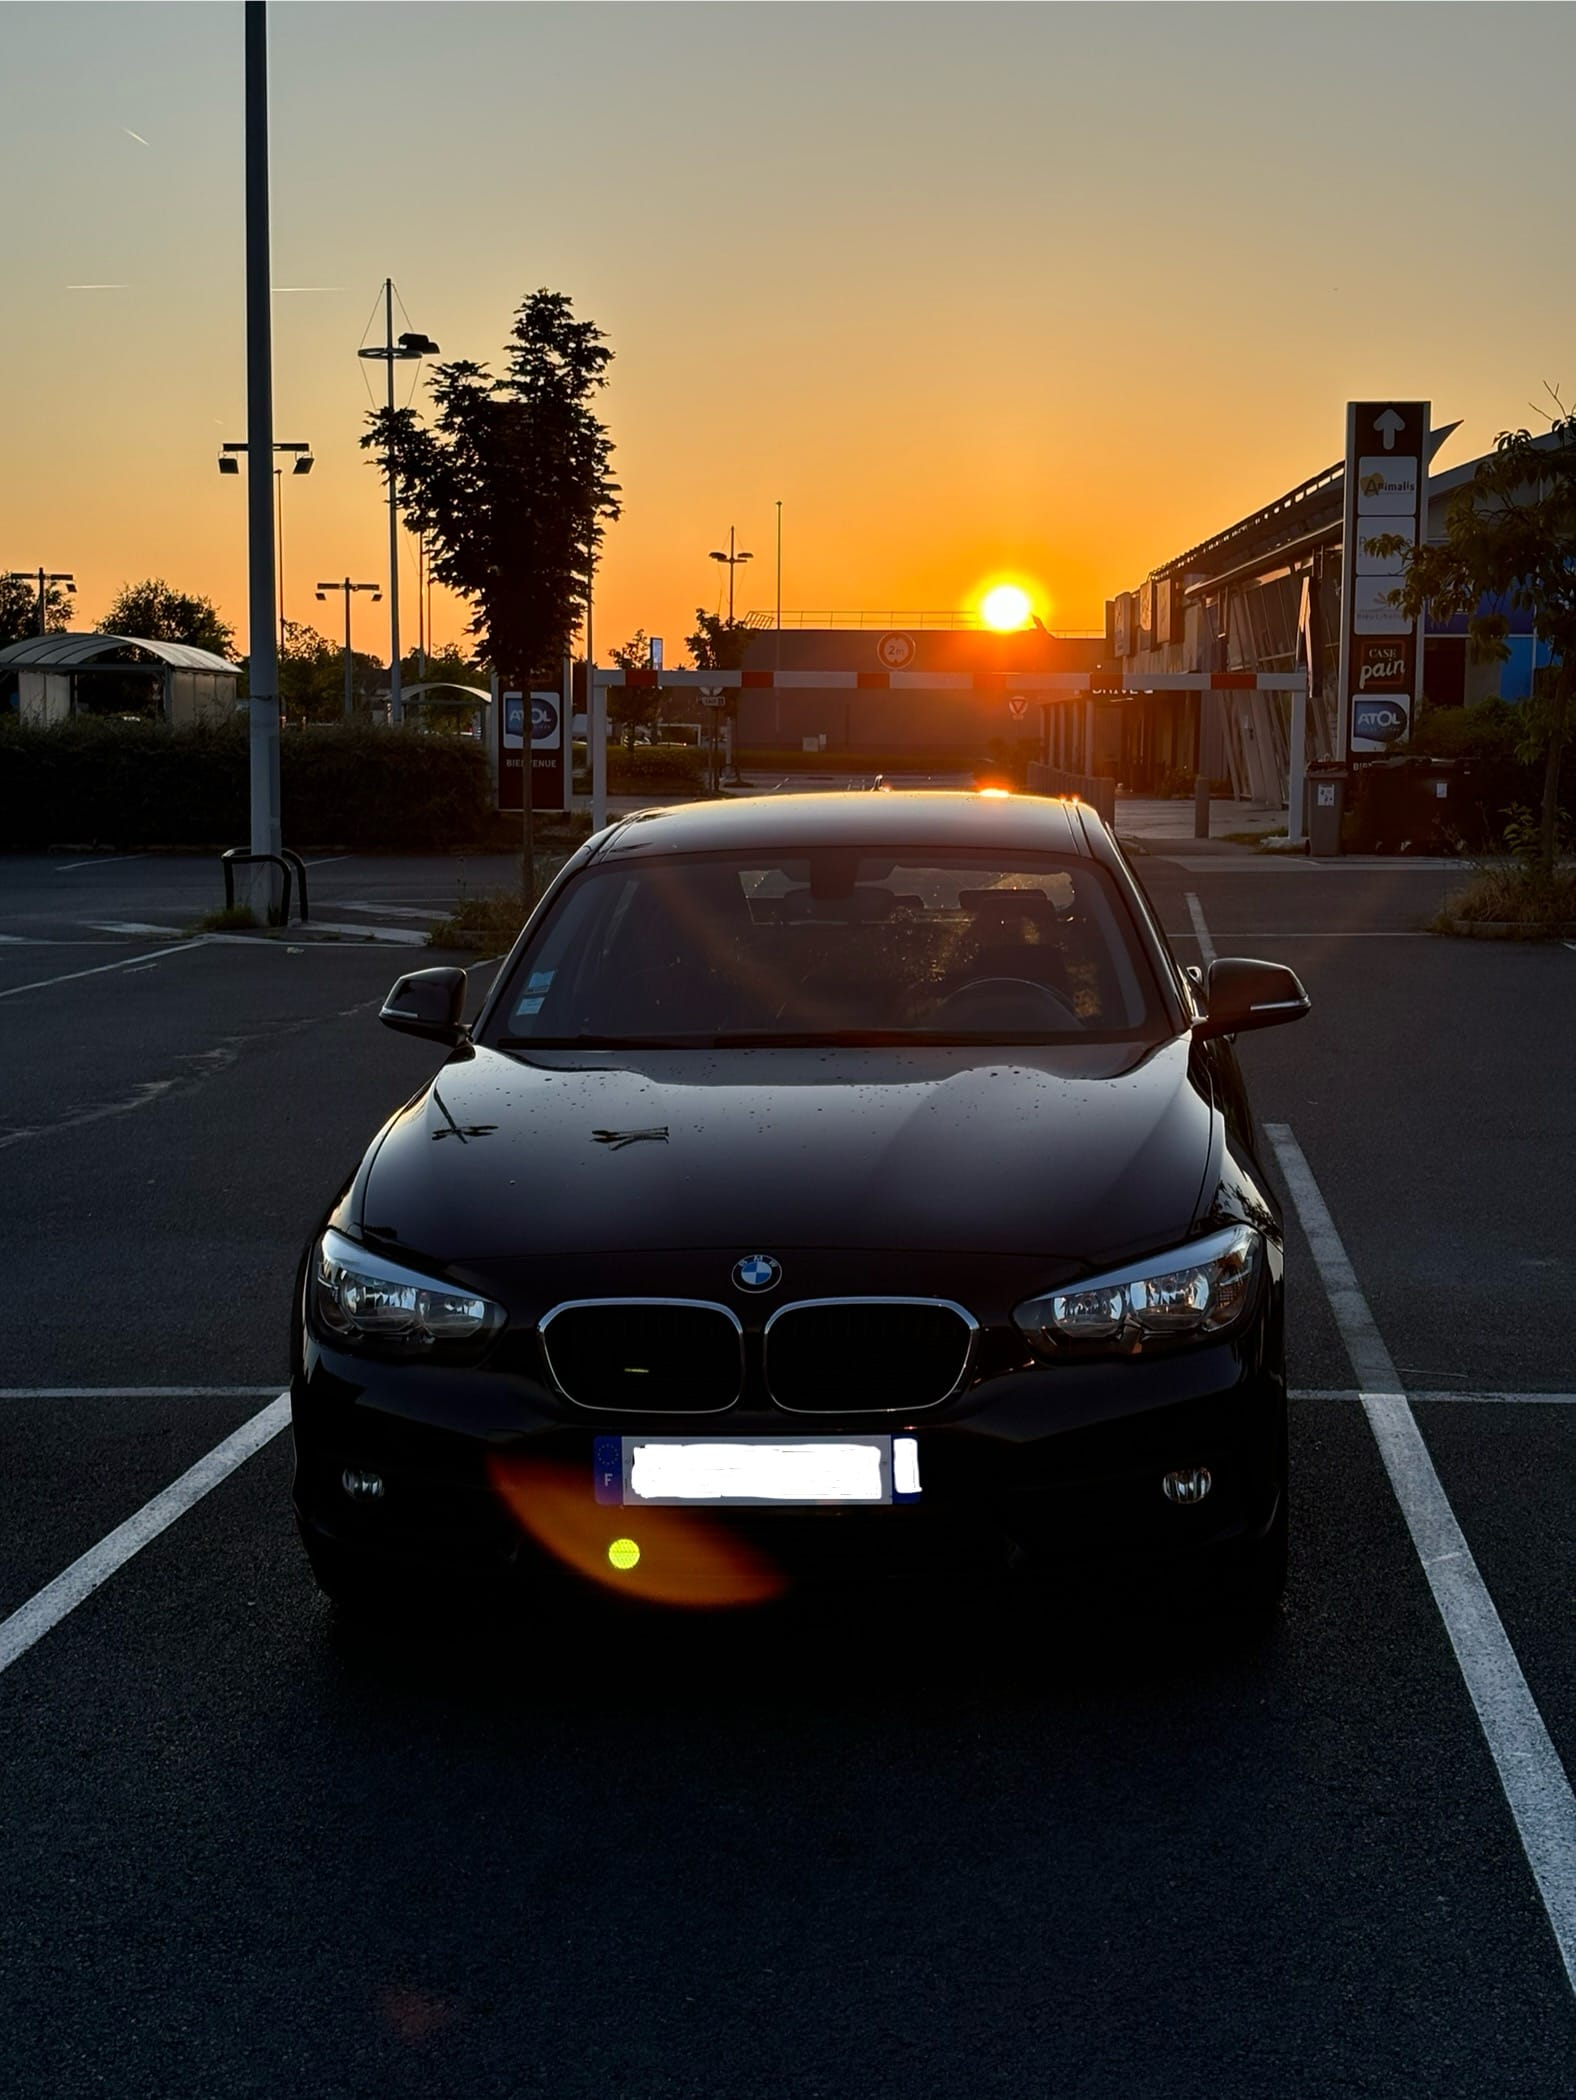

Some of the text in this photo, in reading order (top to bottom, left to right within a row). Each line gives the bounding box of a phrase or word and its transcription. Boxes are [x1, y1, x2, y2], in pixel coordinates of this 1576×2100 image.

[1364, 479, 1415, 496] Animalis
[1368, 648, 1398, 659] CASE
[1358, 658, 1406, 690] pain
[509, 708, 552, 724] AOL
[1357, 710, 1401, 727] ATOL
[604, 1472, 614, 1487] F
